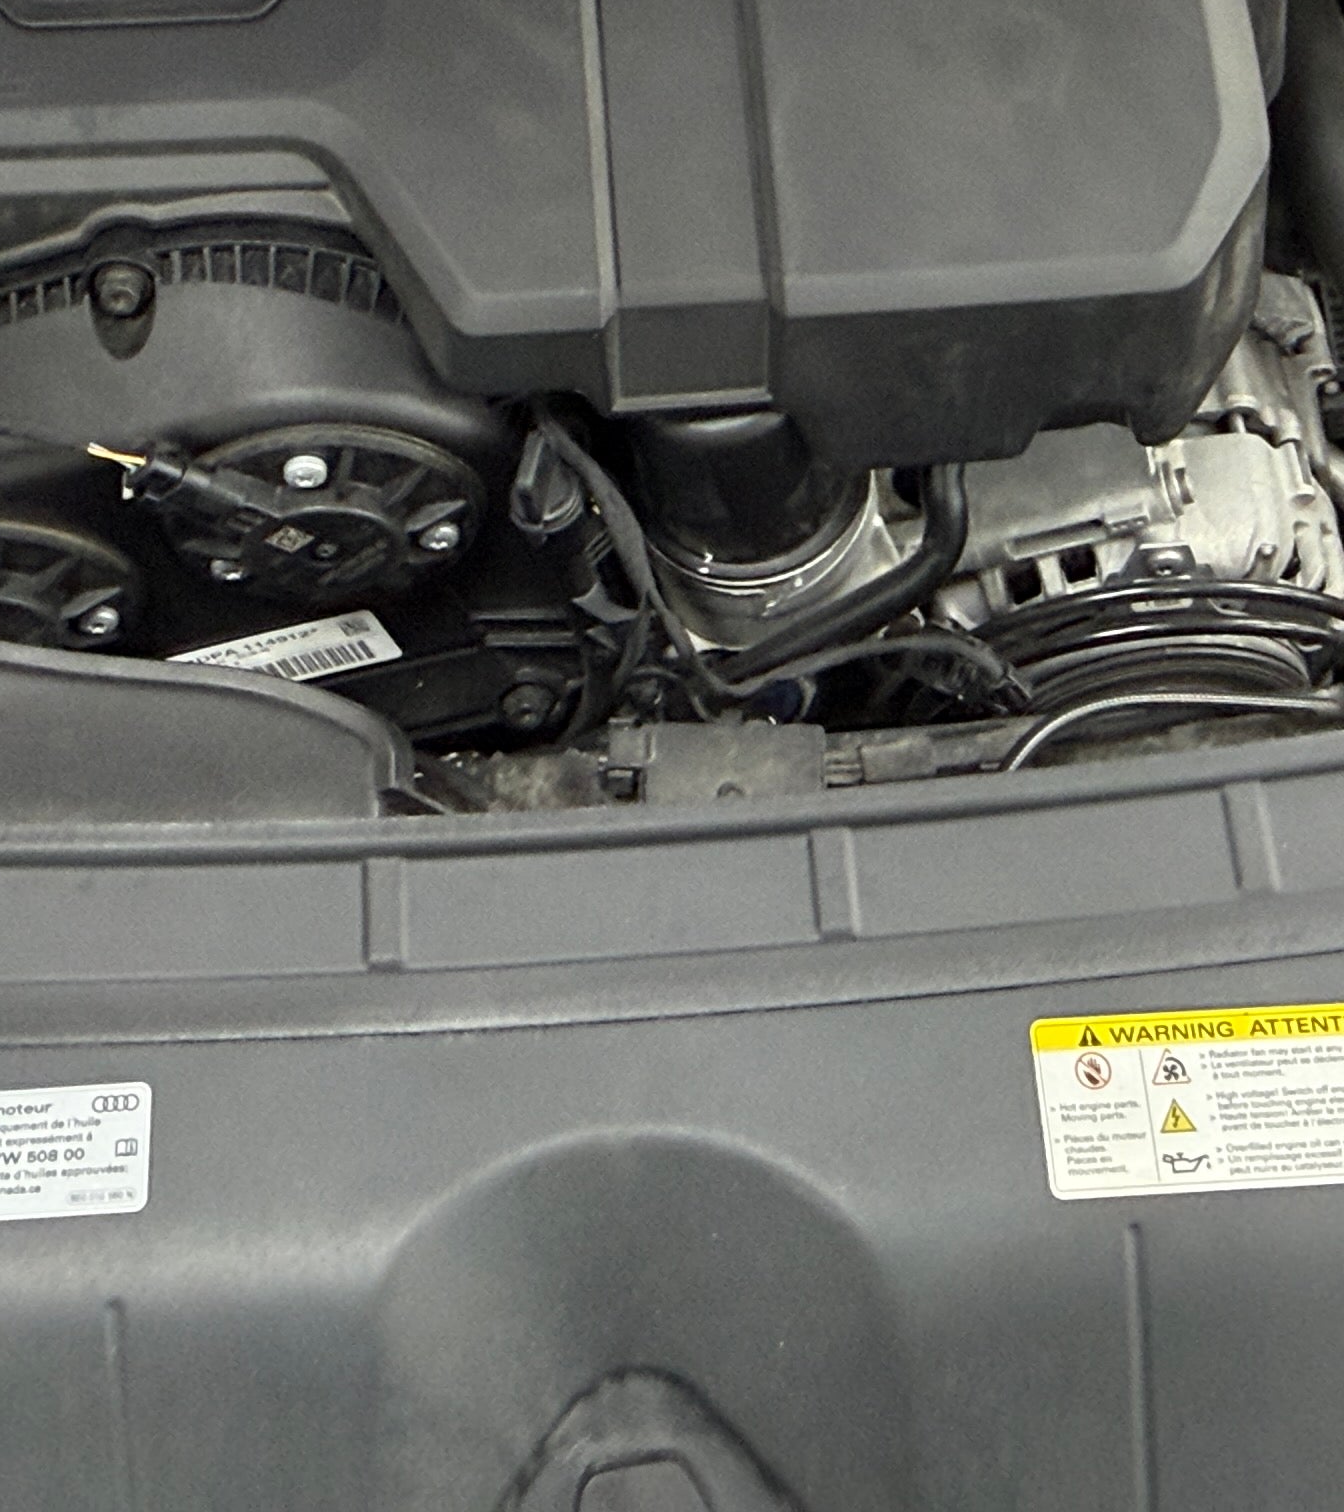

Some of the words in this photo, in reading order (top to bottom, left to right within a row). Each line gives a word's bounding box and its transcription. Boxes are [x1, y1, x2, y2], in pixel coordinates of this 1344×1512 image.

[1109, 1020, 1234, 1044] WARNING
[1251, 1048, 1266, 1056] fan
[1268, 1047, 1288, 1056] may
[1291, 1045, 1312, 1054] start
[1315, 1045, 1323, 1053] at
[1326, 1045, 1342, 1053] any
[1211, 1061, 1222, 1069] Le
[1277, 1057, 1297, 1067] peut
[1221, 1071, 1239, 1079] tout
[1316, 1084, 1328, 1094] off
[1059, 1103, 1076, 1111] Hot
[1079, 1102, 1111, 1112] engine
[1295, 1098, 1326, 1107] engine
[1061, 1113, 1098, 1123] Moving
[51, 1119, 64, 1129] de
[1250, 1122, 1262, 1130] de
[1097, 1132, 1110, 1142] du
[1112, 1131, 1146, 1140] moteur
[1275, 1141, 1307, 1150] engine
[1310, 1139, 1321, 1147] oil
[1324, 1139, 1341, 1147] can
[27, 1149, 58, 1163] 508
[63, 1147, 85, 1161] 00
[1227, 1155, 1242, 1163] Un
[1229, 1166, 1251, 1176] peut
